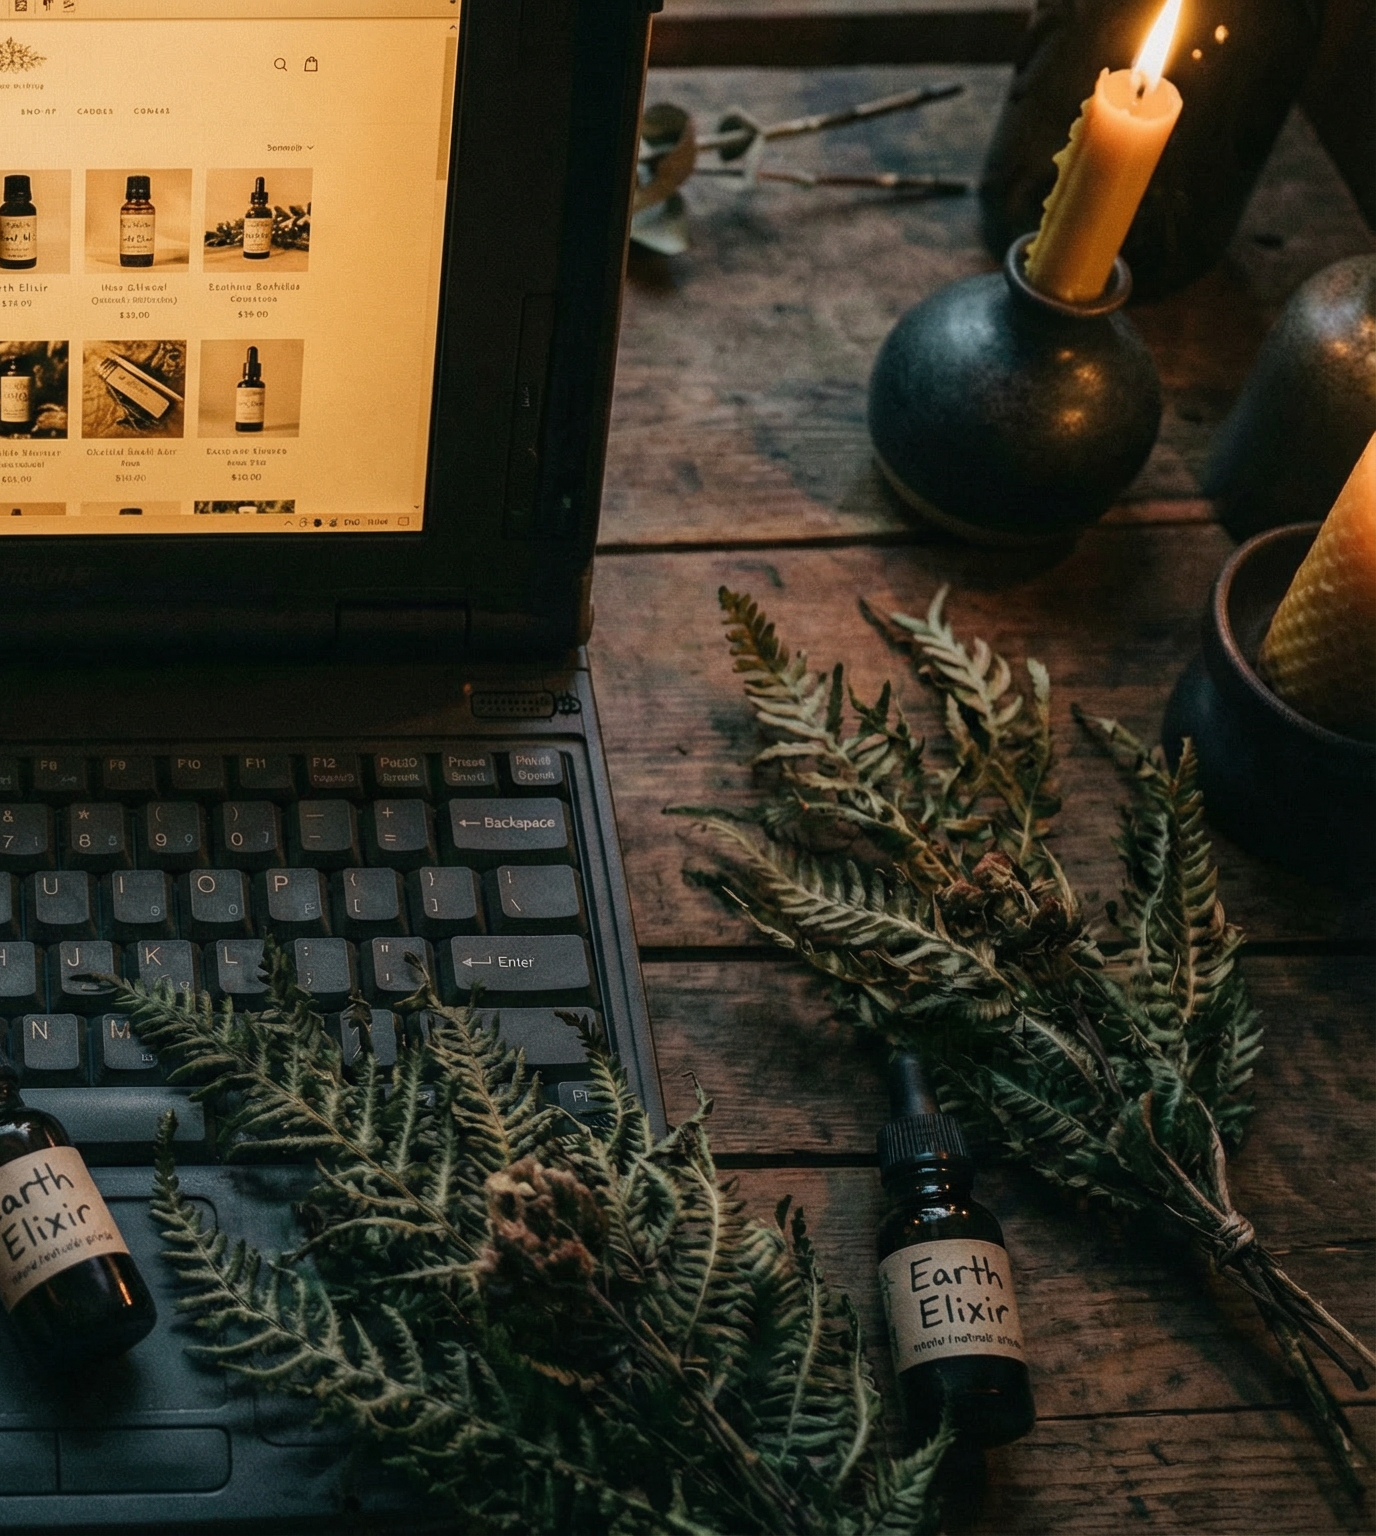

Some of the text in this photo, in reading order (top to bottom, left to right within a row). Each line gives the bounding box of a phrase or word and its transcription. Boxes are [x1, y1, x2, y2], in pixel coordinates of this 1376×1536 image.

[20, 283, 47, 292] Elixir
[178, 759, 200, 769] F10
[246, 758, 265, 768] F11
[313, 758, 335, 768] F12
[3, 811, 13, 822] &
[485, 816, 555, 831] Backspace
[4, 835, 13, 848] 7
[79, 834, 90, 847] 8
[156, 834, 166, 846] 9
[231, 833, 242, 845] 0
[44, 878, 58, 894] U
[198, 876, 215, 892] O
[275, 876, 288, 891] P
[68, 948, 79, 966] J
[146, 947, 161, 965] K
[225, 947, 237, 964] L
[499, 957, 533, 967] Enter
[32, 1021, 47, 1039] N
[111, 1020, 130, 1039] M
[1, 1203, 91, 1262] Elixir
[910, 1254, 1004, 1293] Earth
[919, 1293, 1010, 1329] Elixir
